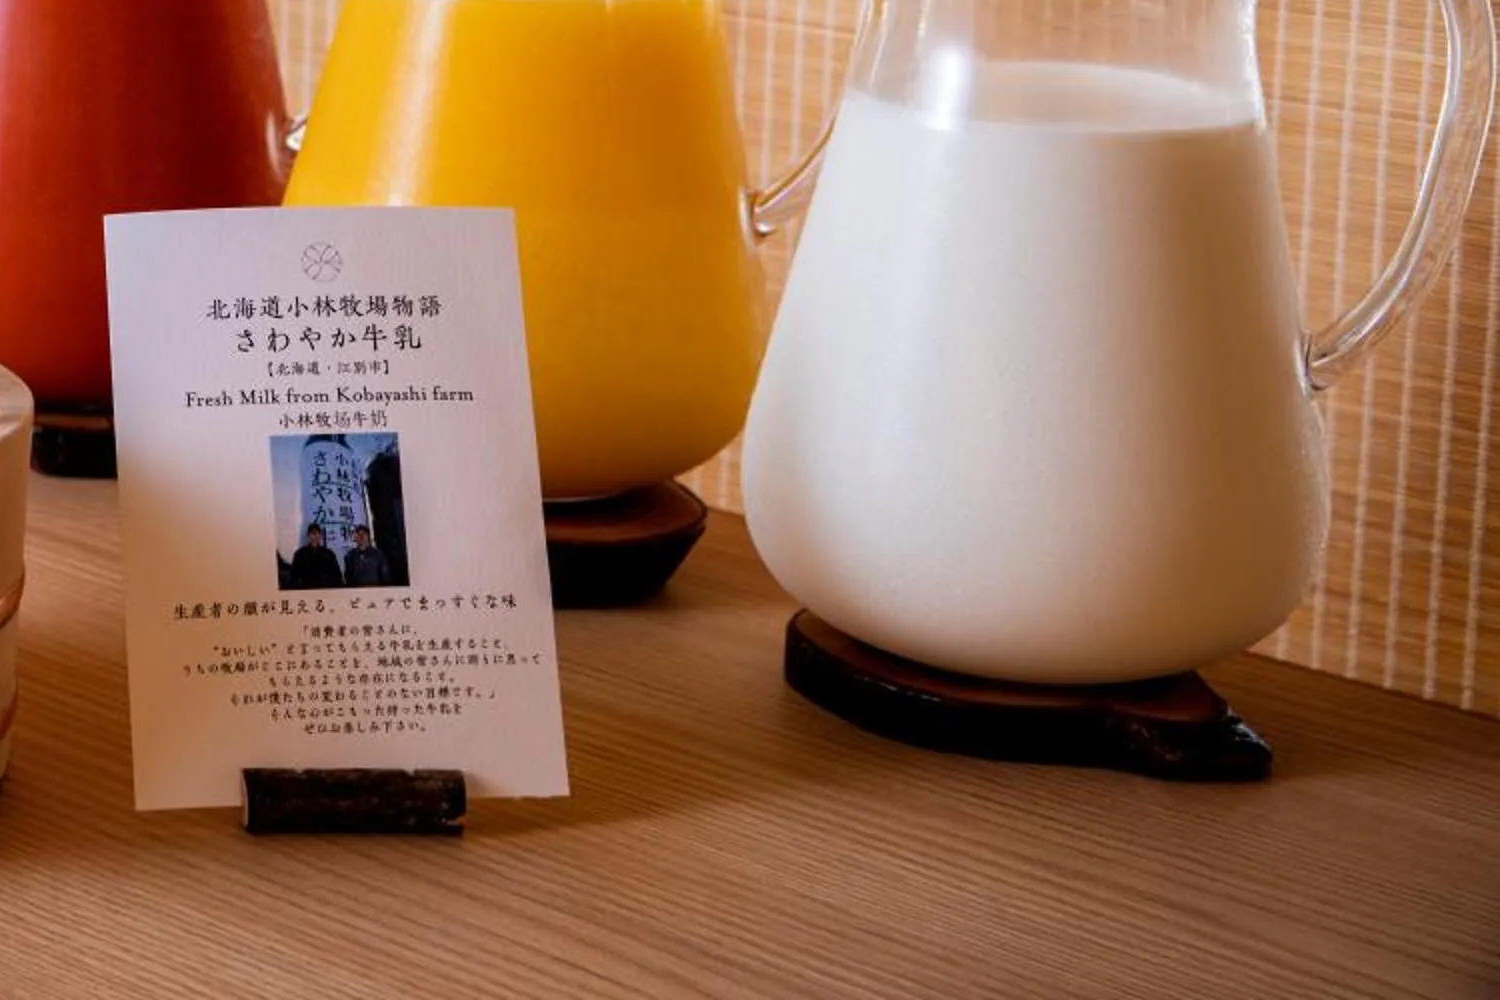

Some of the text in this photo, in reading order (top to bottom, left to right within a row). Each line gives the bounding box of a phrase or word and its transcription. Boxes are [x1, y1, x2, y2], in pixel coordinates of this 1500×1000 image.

[206, 294, 443, 321] 北海道小林牧場物語
[236, 323, 422, 353] さわやか牛乳
[185, 385, 474, 408] Fresh Milk from Kobayashi farm
